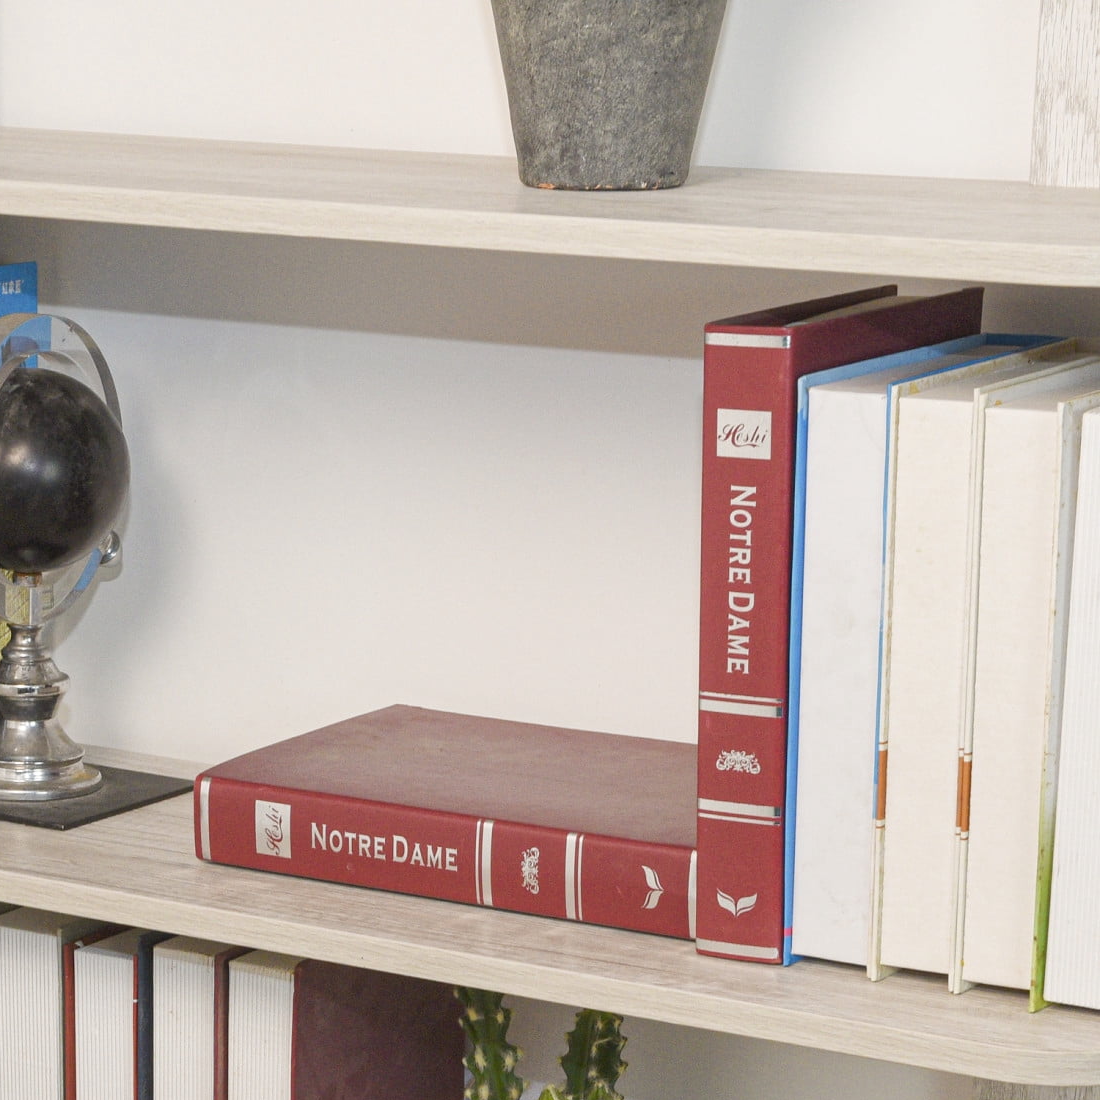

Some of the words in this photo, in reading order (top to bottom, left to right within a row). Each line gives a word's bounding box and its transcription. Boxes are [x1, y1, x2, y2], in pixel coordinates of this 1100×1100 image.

[729, 485, 757, 584] NOTRE
[725, 590, 754, 675] DAME
[311, 822, 386, 861] NOTRE
[393, 834, 458, 872] DAME
